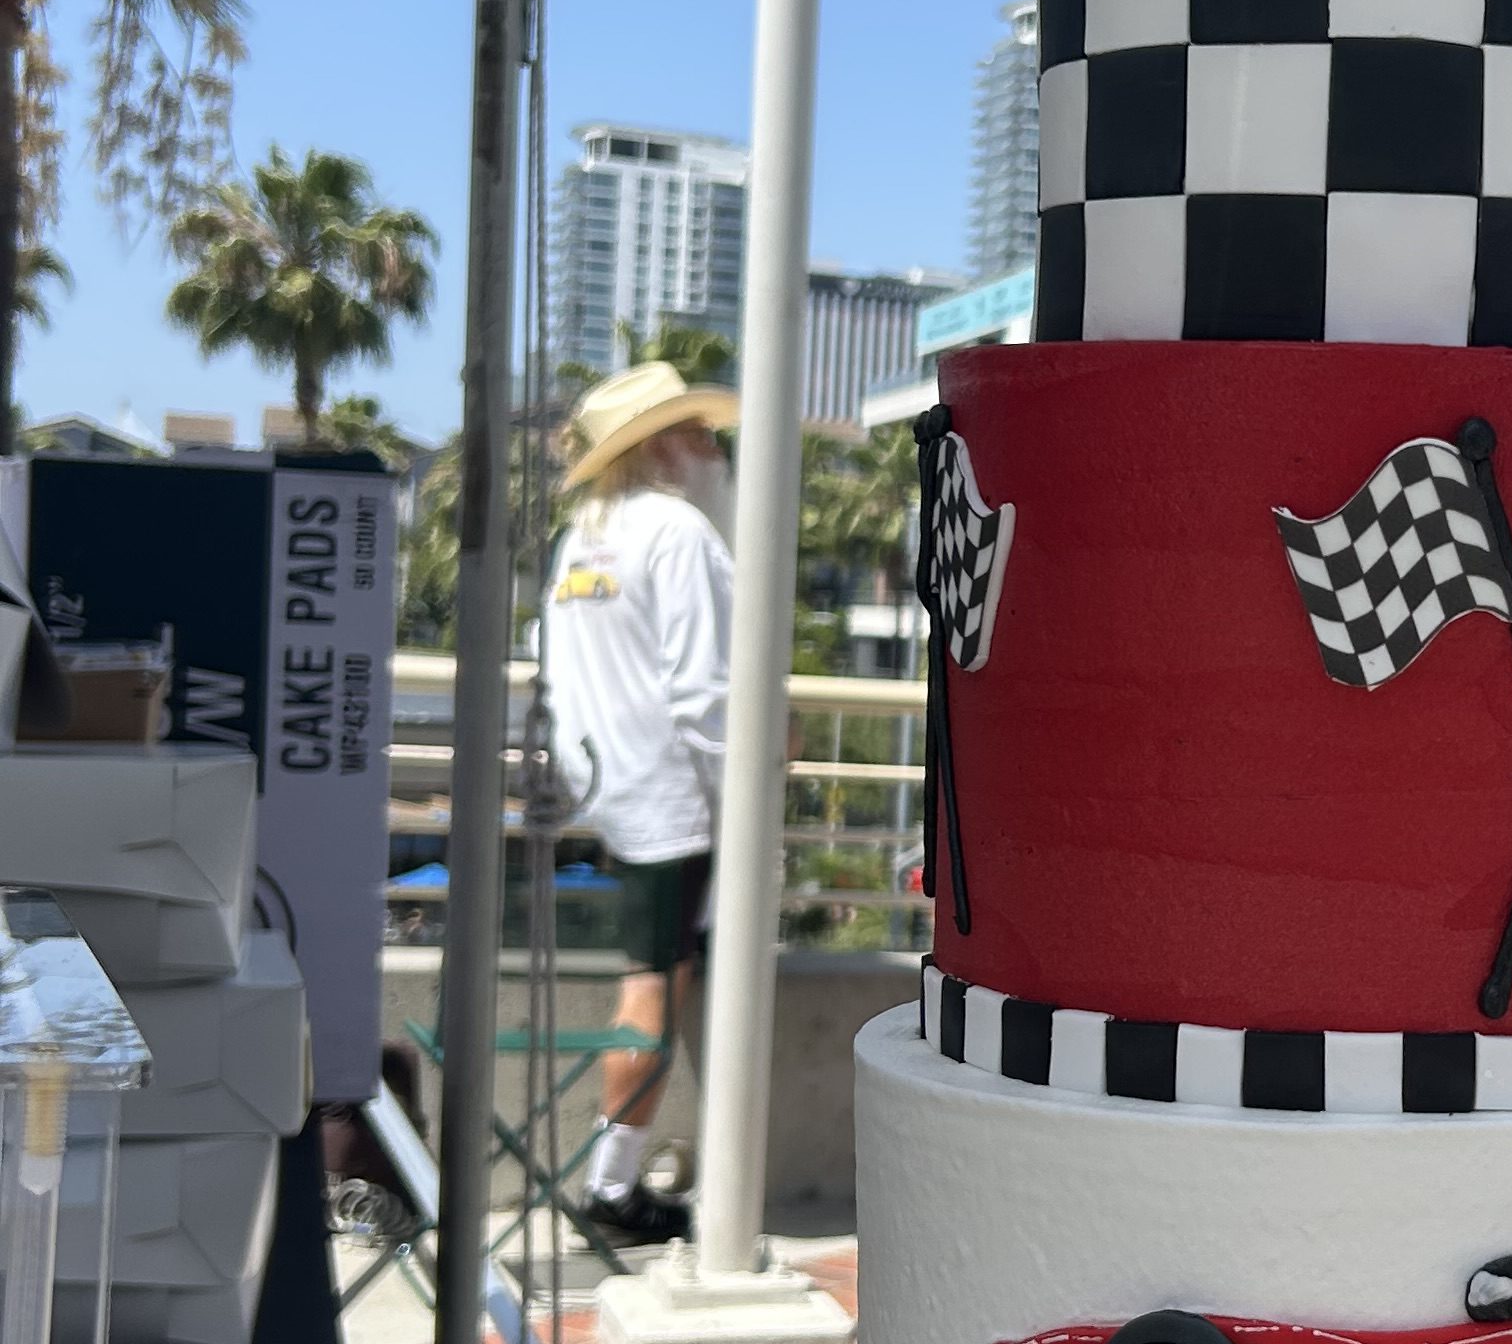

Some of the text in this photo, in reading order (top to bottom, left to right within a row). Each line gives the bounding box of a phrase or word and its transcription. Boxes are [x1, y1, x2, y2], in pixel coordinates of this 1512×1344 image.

[355, 495, 377, 560] COUNT
[280, 497, 339, 772] CAKE PADS
